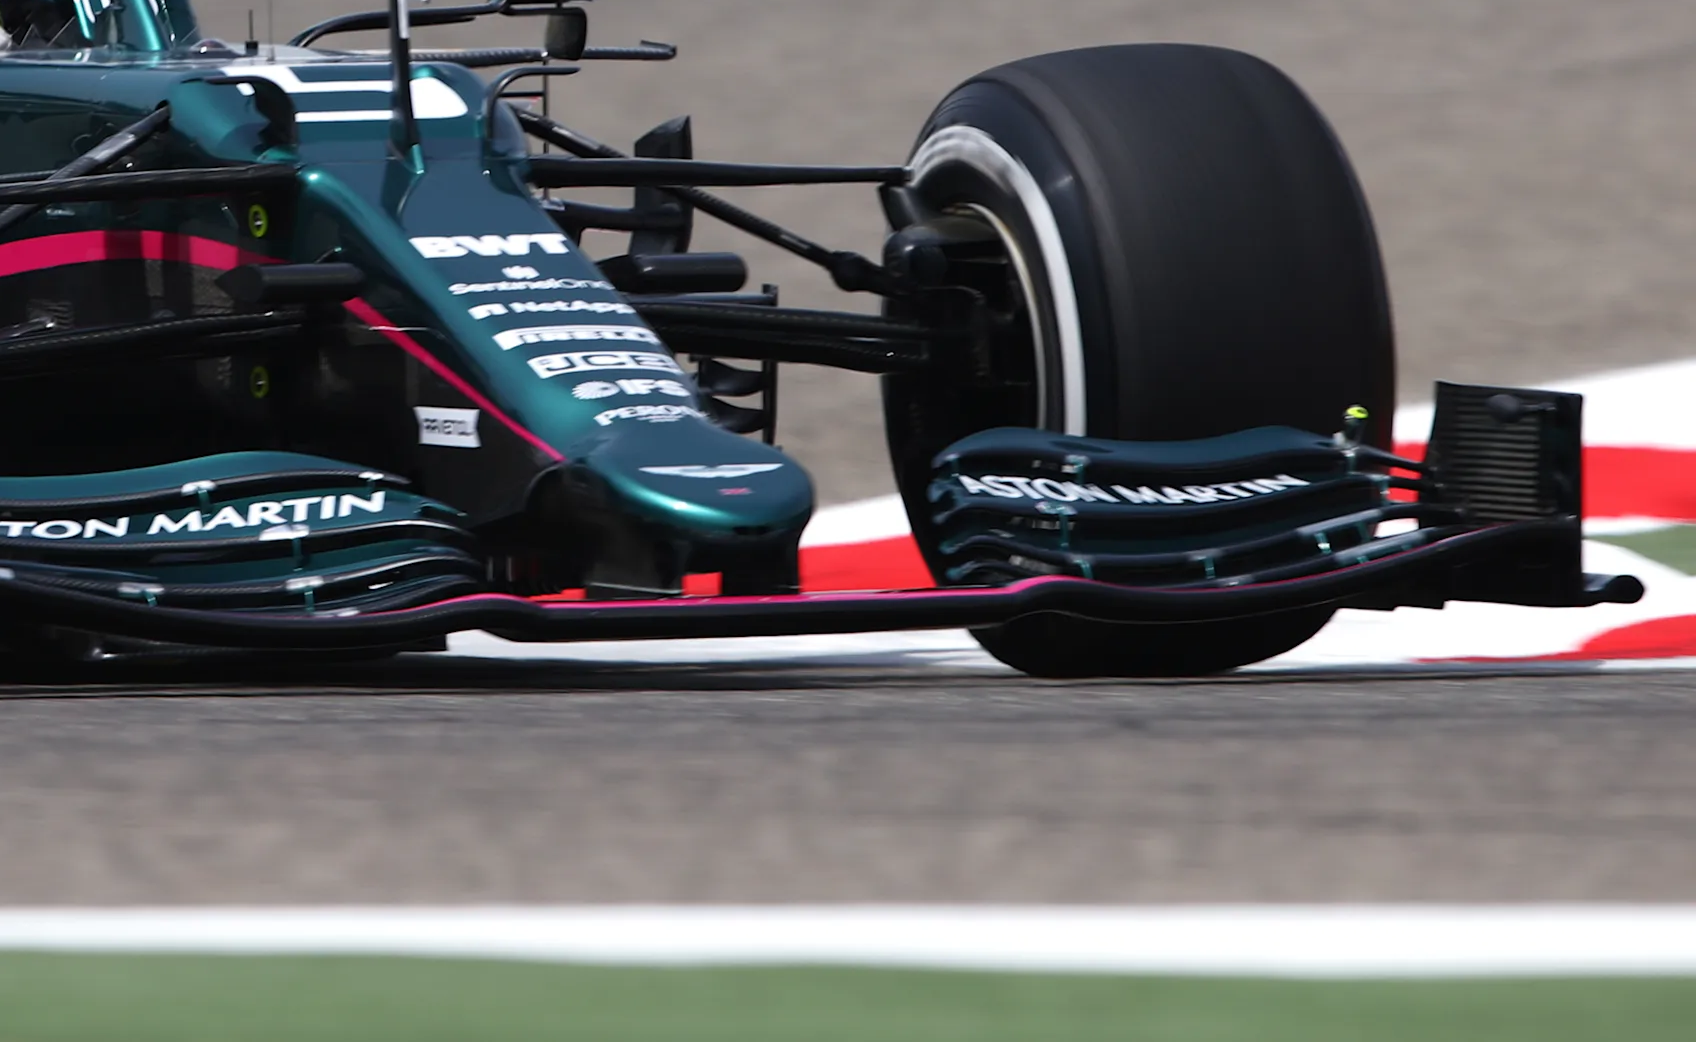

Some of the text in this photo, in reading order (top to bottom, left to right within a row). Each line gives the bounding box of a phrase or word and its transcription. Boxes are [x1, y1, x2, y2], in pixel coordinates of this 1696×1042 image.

[408, 233, 571, 259] BWT
[615, 378, 692, 398] IFS
[957, 473, 1311, 505] ASTON MARTIN
[147, 490, 388, 536] MARTIN
